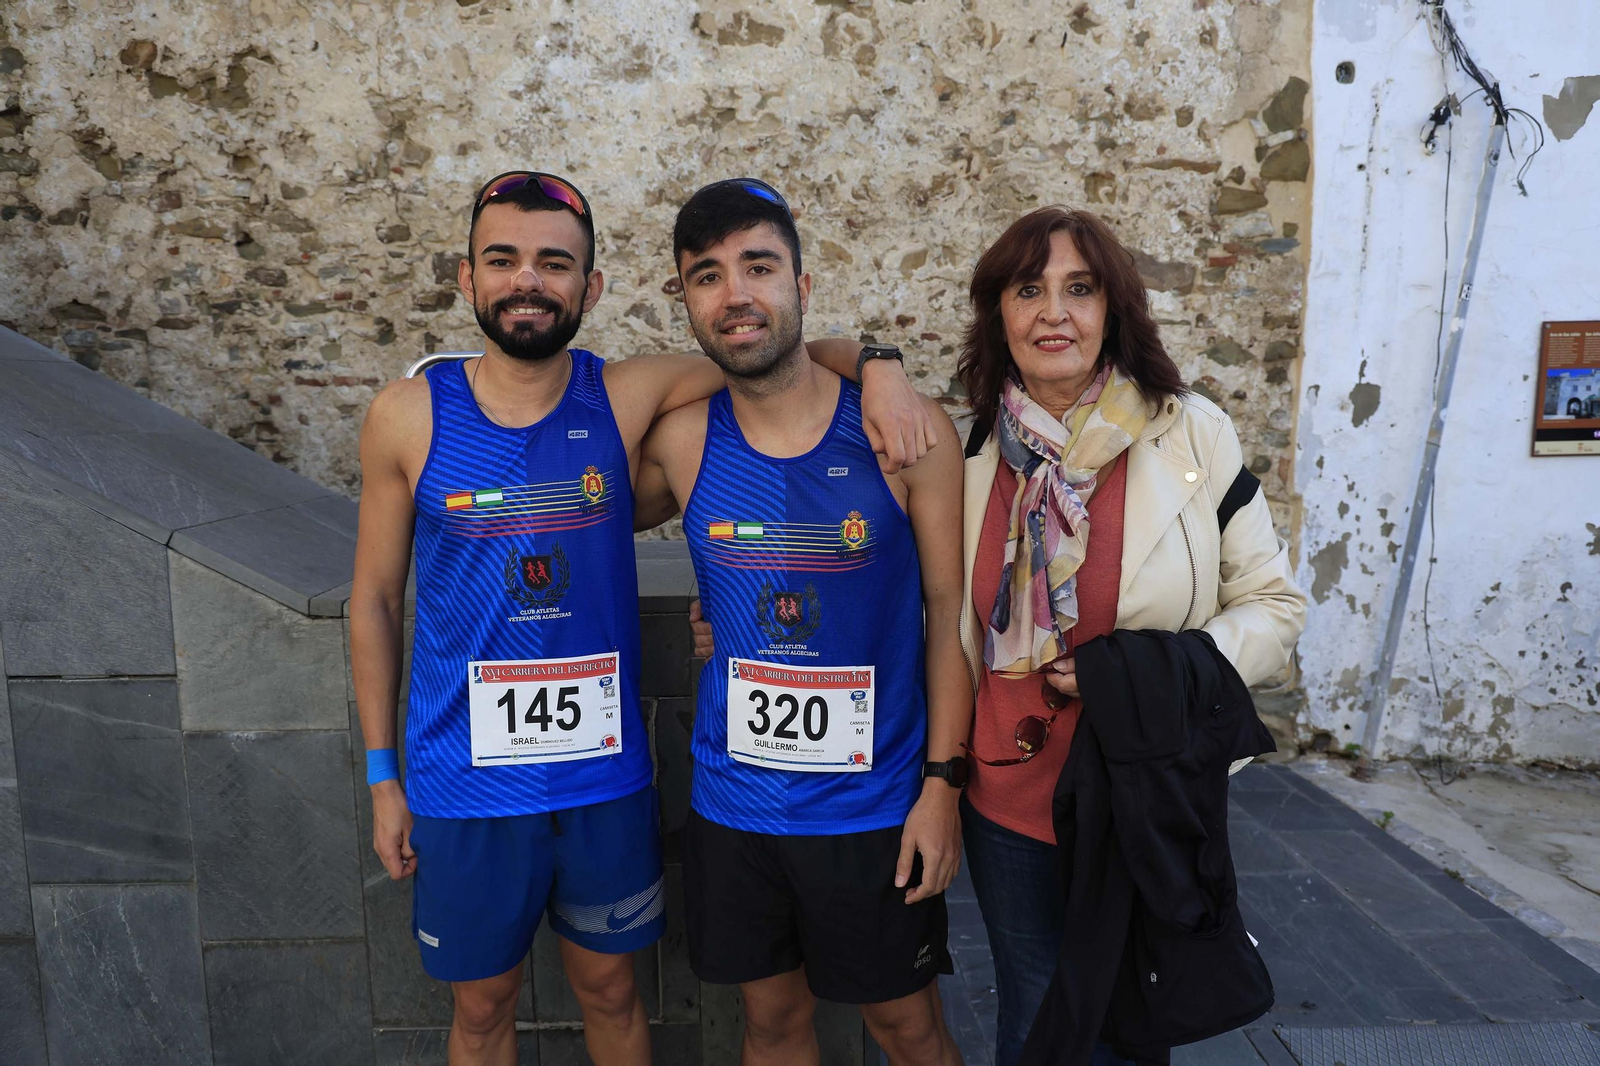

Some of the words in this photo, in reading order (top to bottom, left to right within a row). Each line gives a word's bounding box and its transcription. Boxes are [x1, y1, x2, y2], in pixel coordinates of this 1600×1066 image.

[507, 614, 542, 622] VETERANOS
[542, 611, 572, 620] ALGECIRAS
[520, 608, 536, 616] CLUB
[536, 606, 560, 614] ATLETAS
[502, 665, 546, 676] CARRERA
[547, 665, 567, 676] DEL
[568, 659, 615, 675] ESTRECHO
[755, 668, 796, 682] CARRERA
[797, 673, 816, 683] DEL
[817, 673, 869, 683] ESTRECHO
[497, 686, 582, 734] 145
[747, 689, 829, 742] 320
[511, 737, 539, 746] ISRAEL
[754, 738, 798, 752] GUILLERMO
